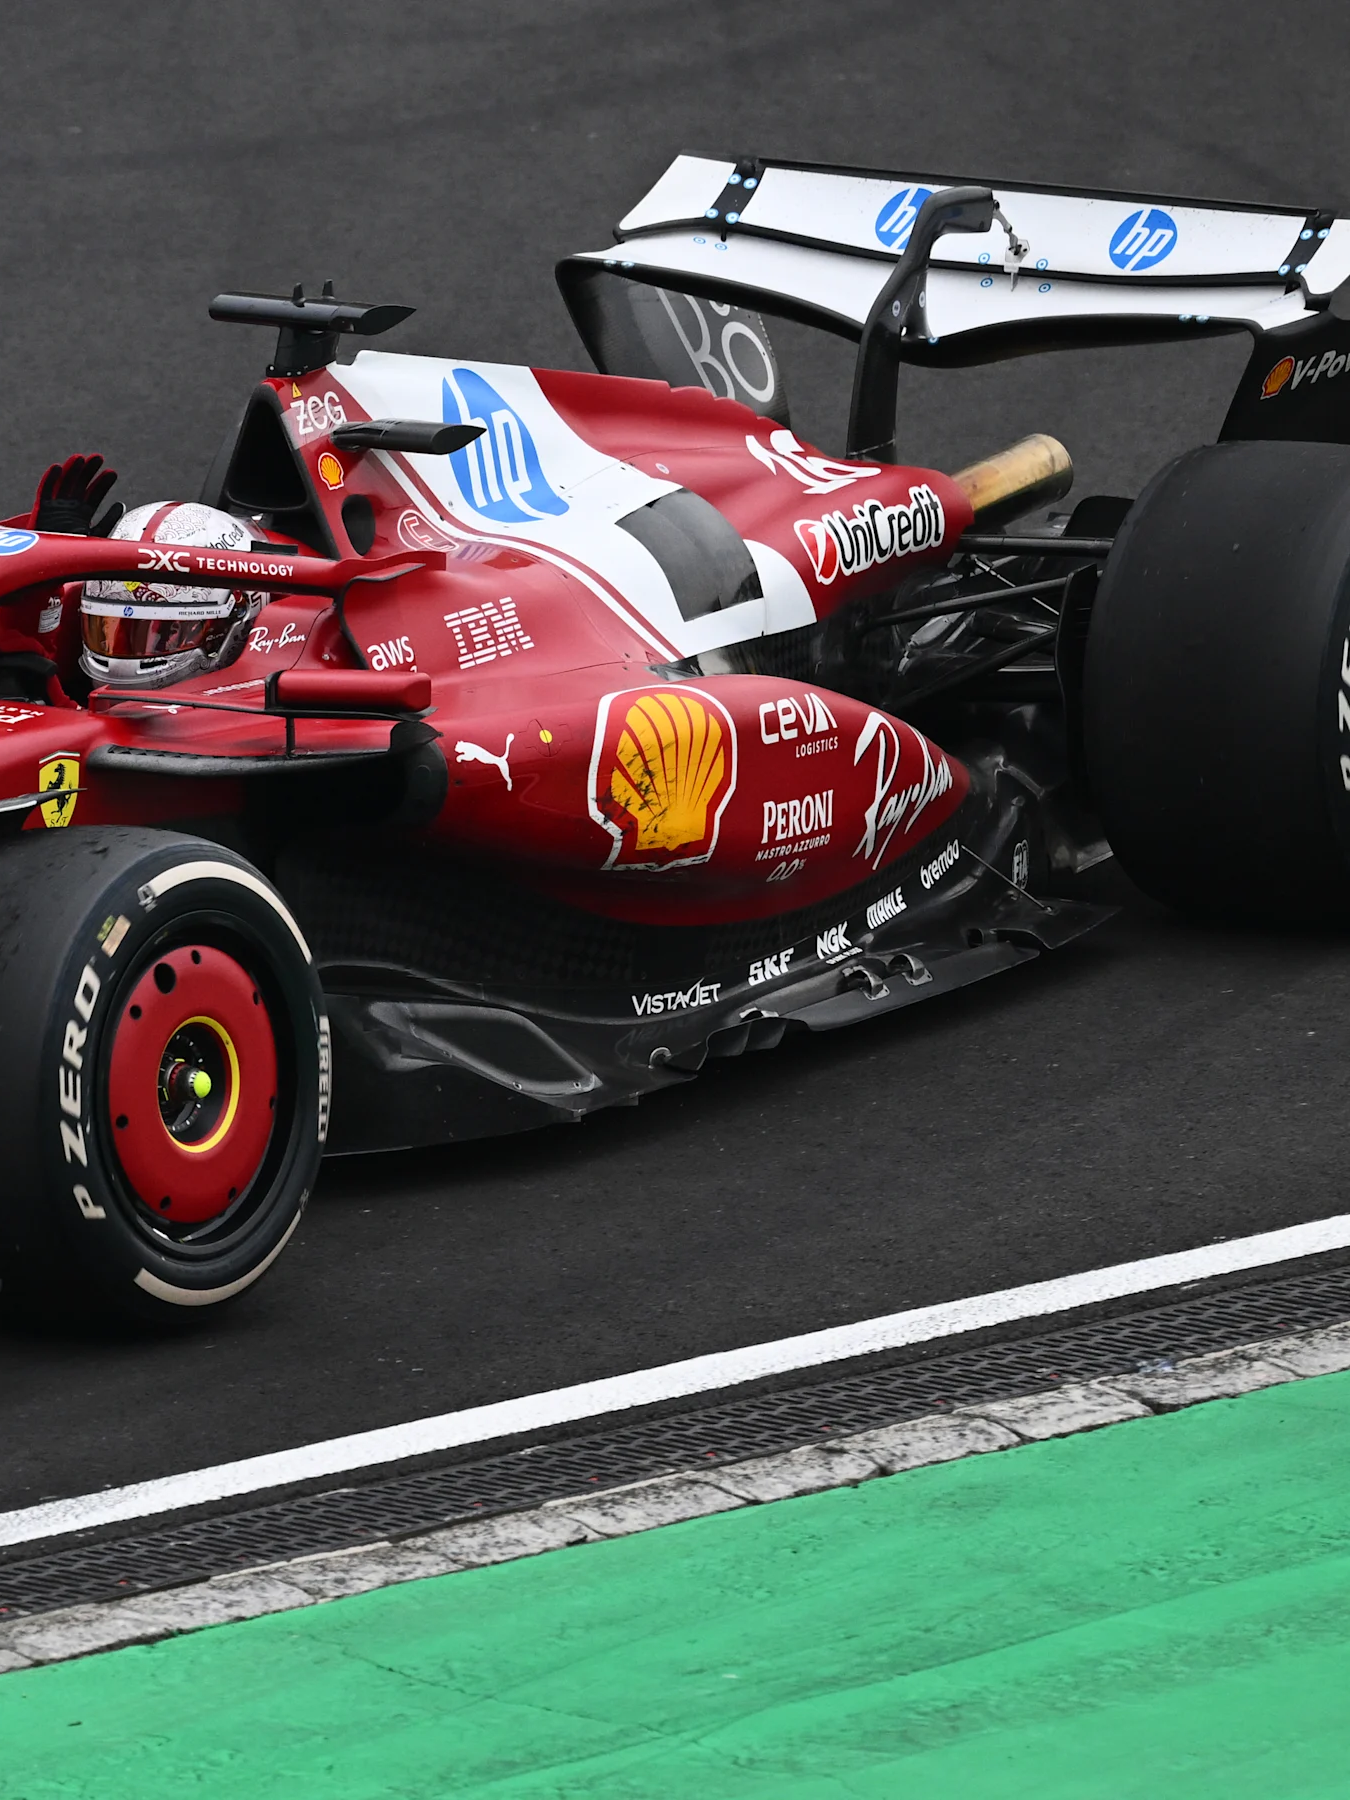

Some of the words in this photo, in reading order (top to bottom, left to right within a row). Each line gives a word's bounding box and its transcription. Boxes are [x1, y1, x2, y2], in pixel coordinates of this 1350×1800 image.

[1111, 209, 1175, 271] hp
[444, 370, 550, 521] hp
[745, 430, 882, 494] 16
[821, 485, 944, 573] UniCredit
[138, 548, 190, 573] DXC
[196, 557, 294, 576] TECHNOLOGY
[367, 636, 415, 671] aws
[443, 597, 535, 670] IBM
[795, 737, 838, 758] LOGISTICS
[761, 789, 834, 844] PERONI
[755, 843, 792, 862] NASTRO
[792, 834, 830, 853] AZZURRO
[920, 839, 960, 890] brembo
[866, 886, 907, 930] MAHLE
[816, 921, 853, 960] NGK
[748, 948, 795, 986] SKF
[632, 977, 721, 1016] VISTAJET
[59, 964, 103, 1168] ZERO
[318, 1015, 333, 1144] PIRELLI
[73, 1184, 107, 1220] P
